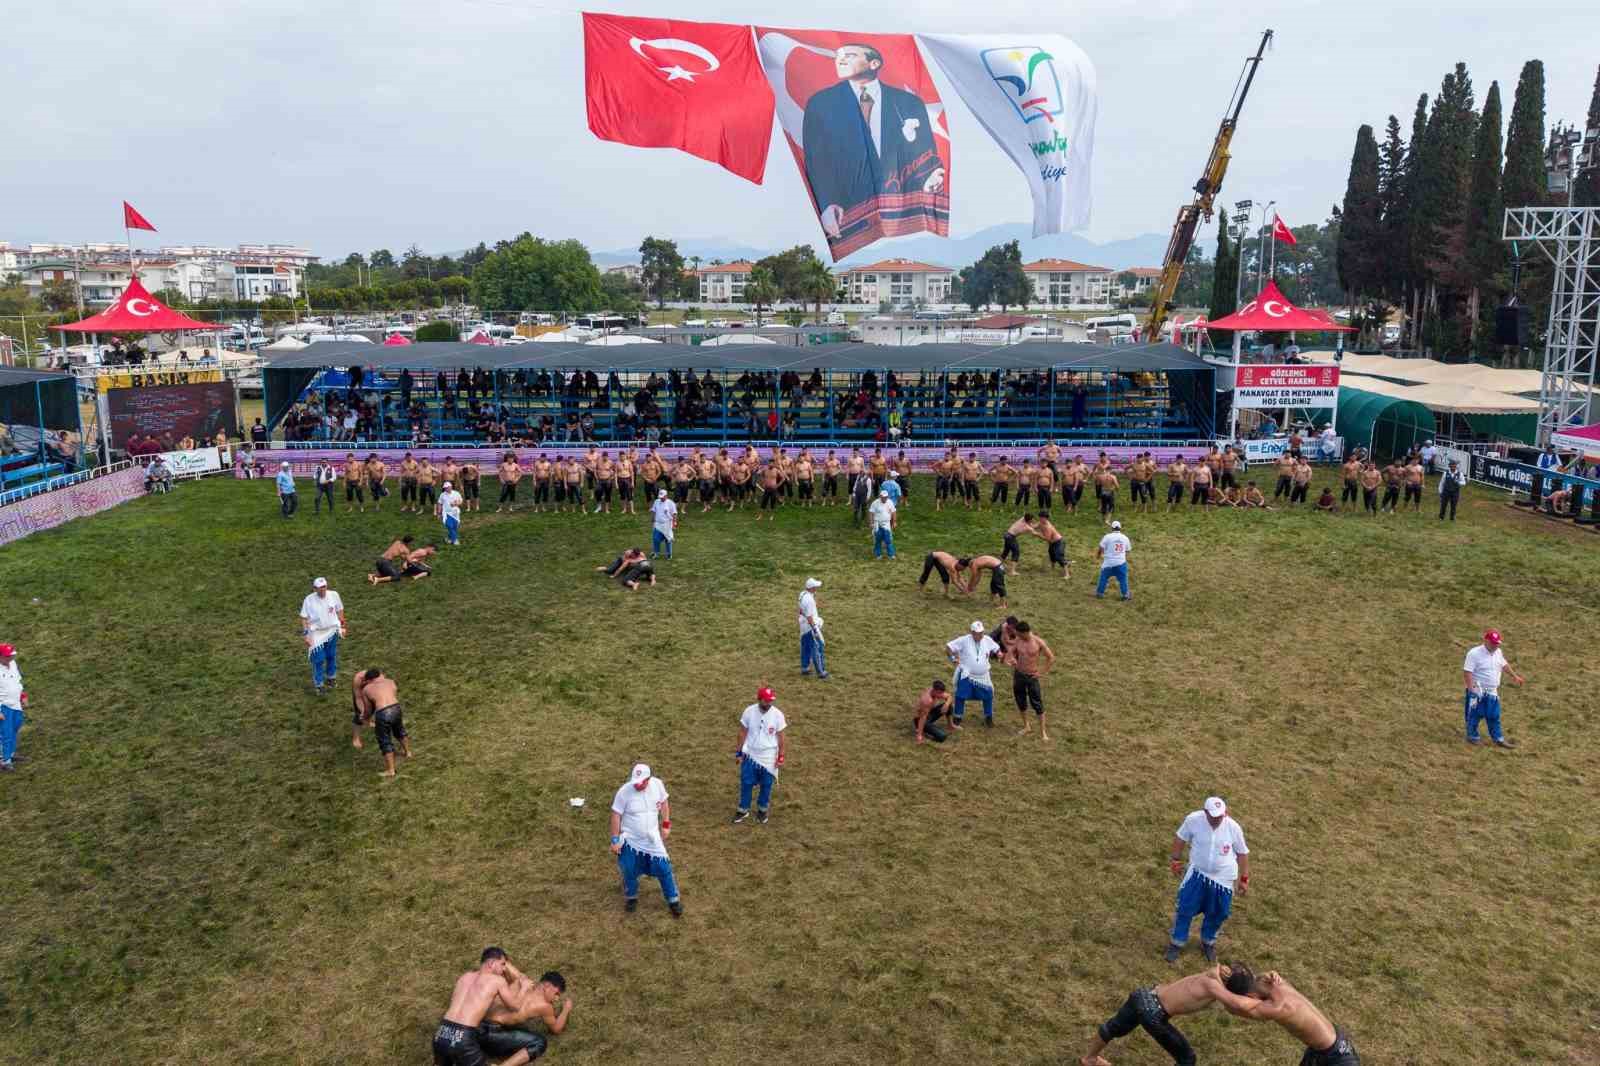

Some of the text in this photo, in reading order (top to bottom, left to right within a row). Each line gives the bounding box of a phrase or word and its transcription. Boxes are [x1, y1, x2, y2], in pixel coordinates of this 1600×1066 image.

[1259, 377, 1287, 385] CETVEL
[1239, 389, 1279, 397] MANAVGAT
[1281, 389, 1290, 397] ER
[1262, 397, 1278, 406] HOŞ
